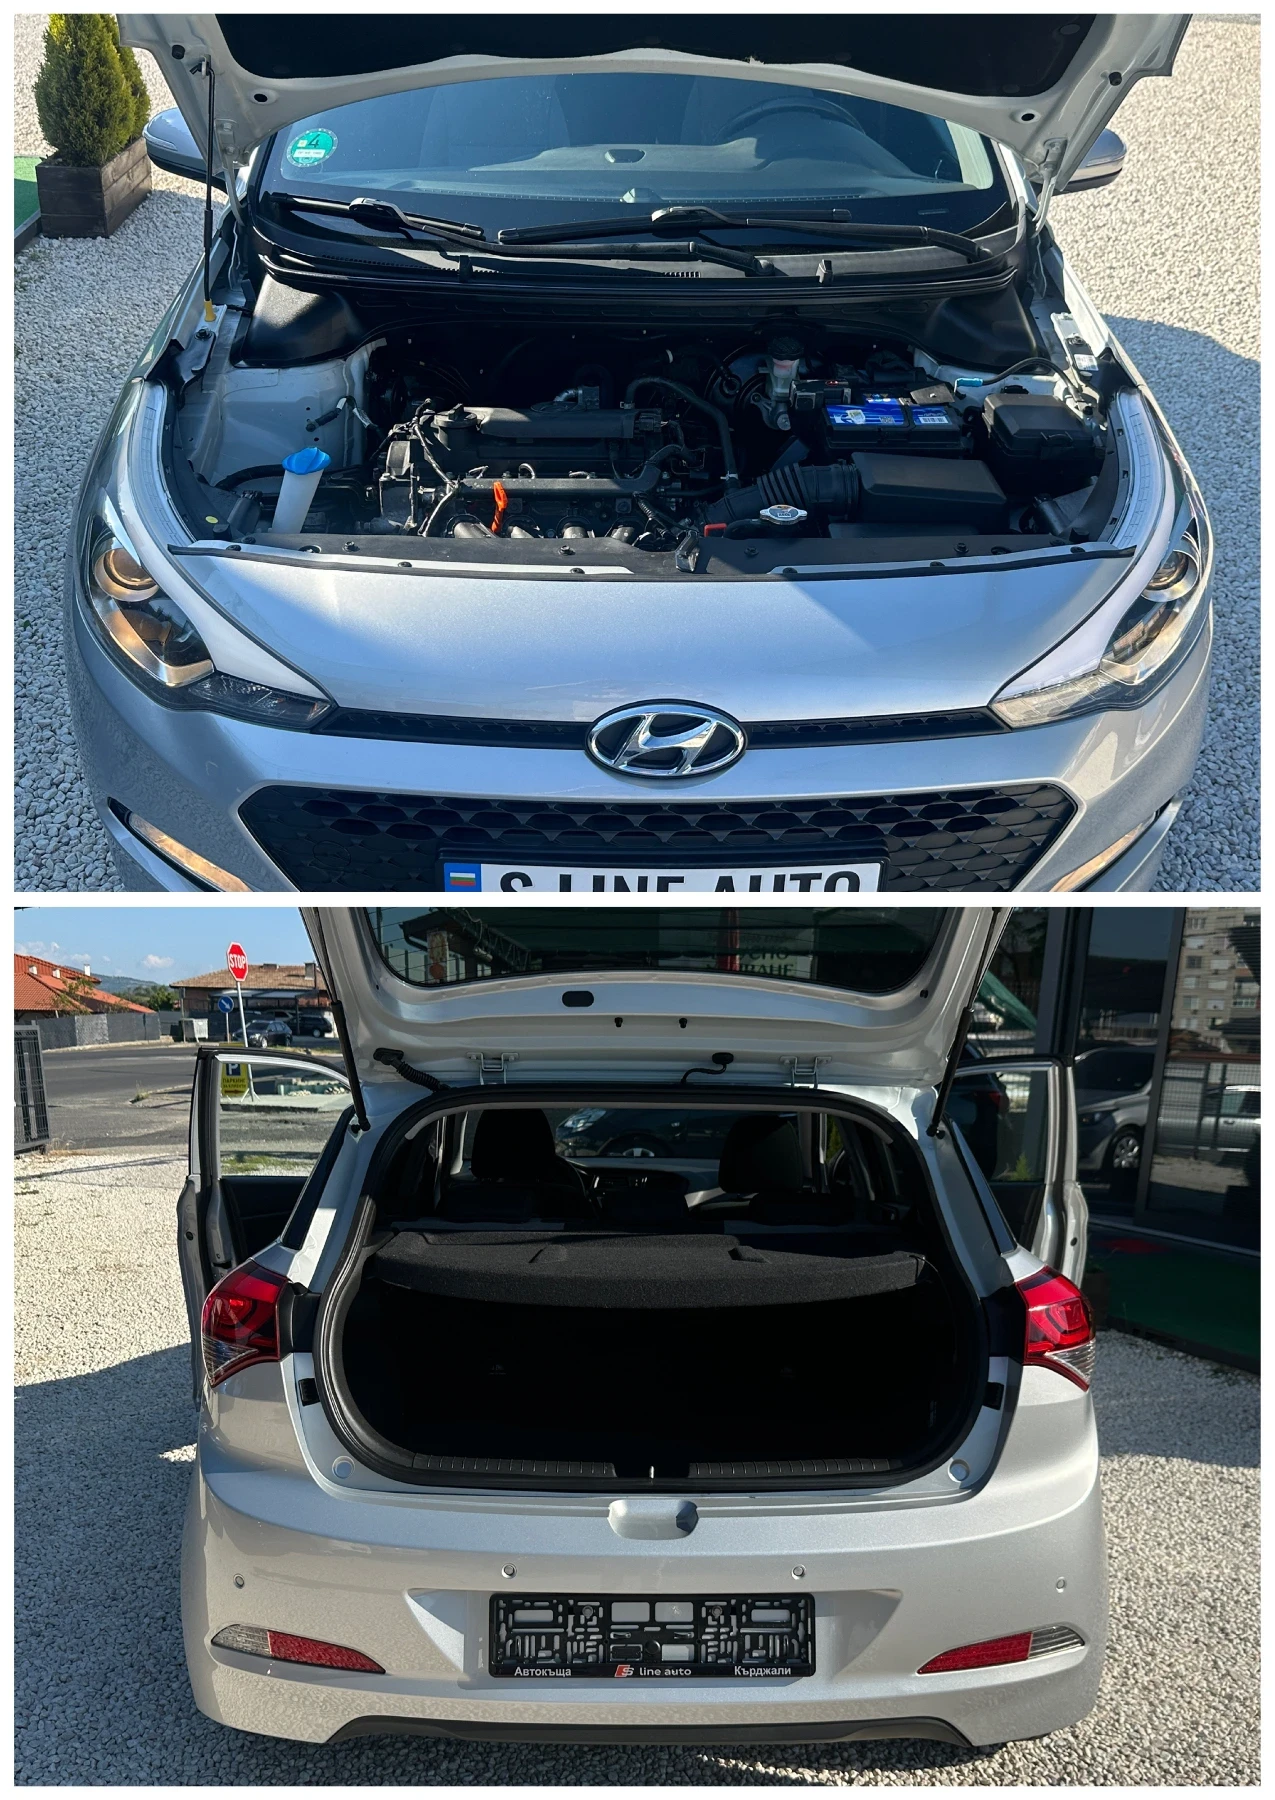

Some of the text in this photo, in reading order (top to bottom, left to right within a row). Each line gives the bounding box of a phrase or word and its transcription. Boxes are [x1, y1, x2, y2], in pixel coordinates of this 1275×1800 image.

[308, 134, 320, 148] 4
[230, 954, 246, 969] STOP
[229, 1063, 239, 1075] P
[514, 1666, 572, 1677] Автокъща
[639, 1667, 662, 1676] line
[664, 1668, 692, 1676] auto
[734, 1665, 792, 1677] Кърджали
